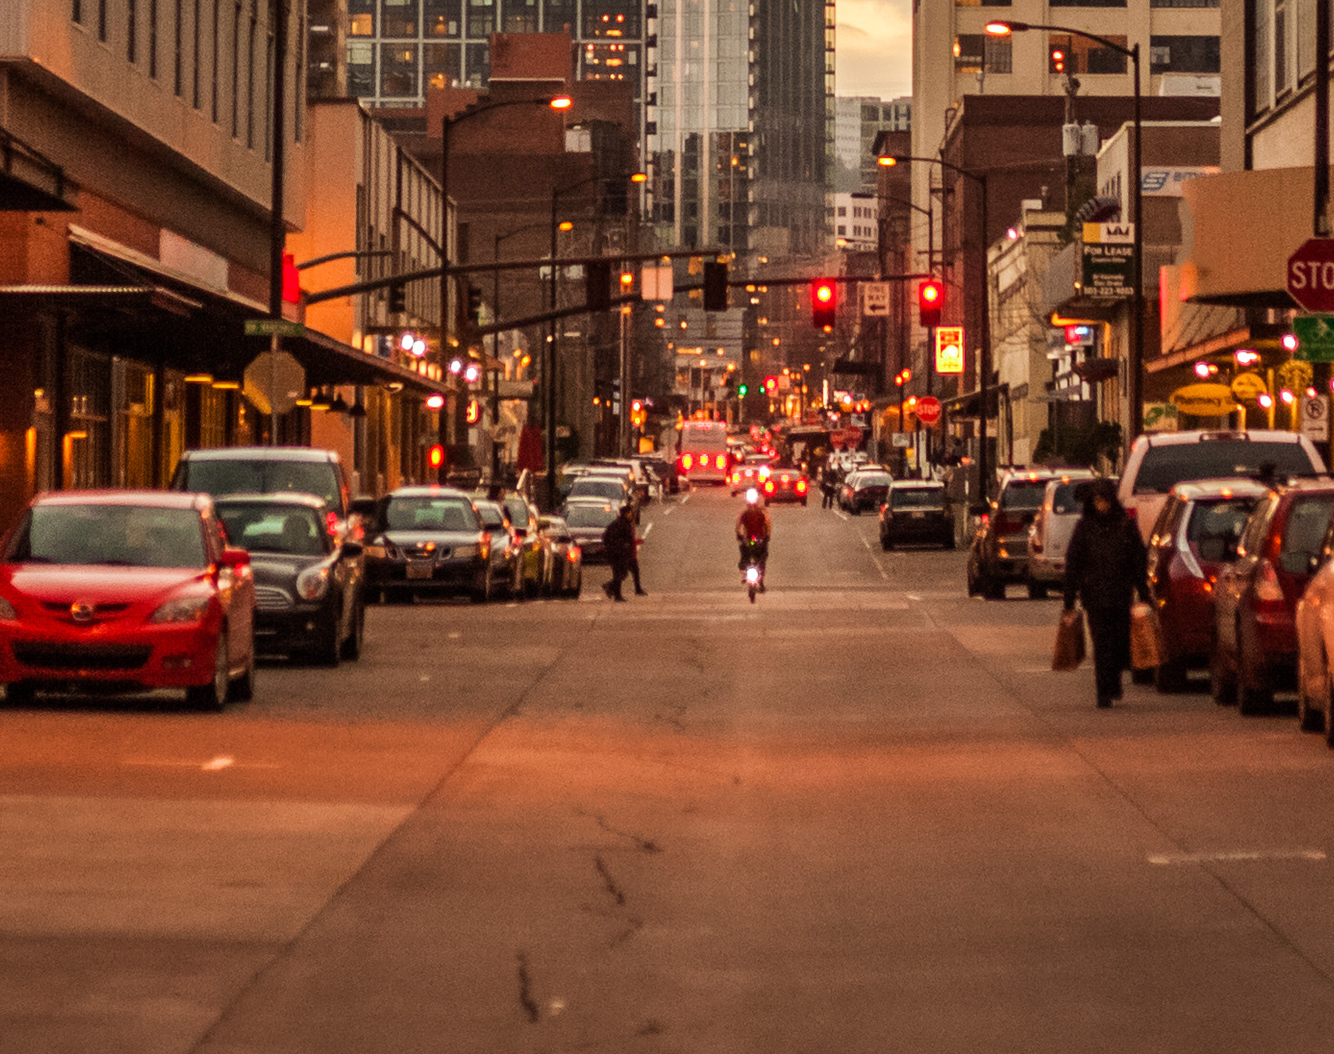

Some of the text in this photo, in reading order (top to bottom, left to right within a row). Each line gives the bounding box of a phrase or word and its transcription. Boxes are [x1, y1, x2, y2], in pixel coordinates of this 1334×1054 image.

[1084, 245, 1133, 256] FOR LEASE
[916, 404, 941, 415] STOP
